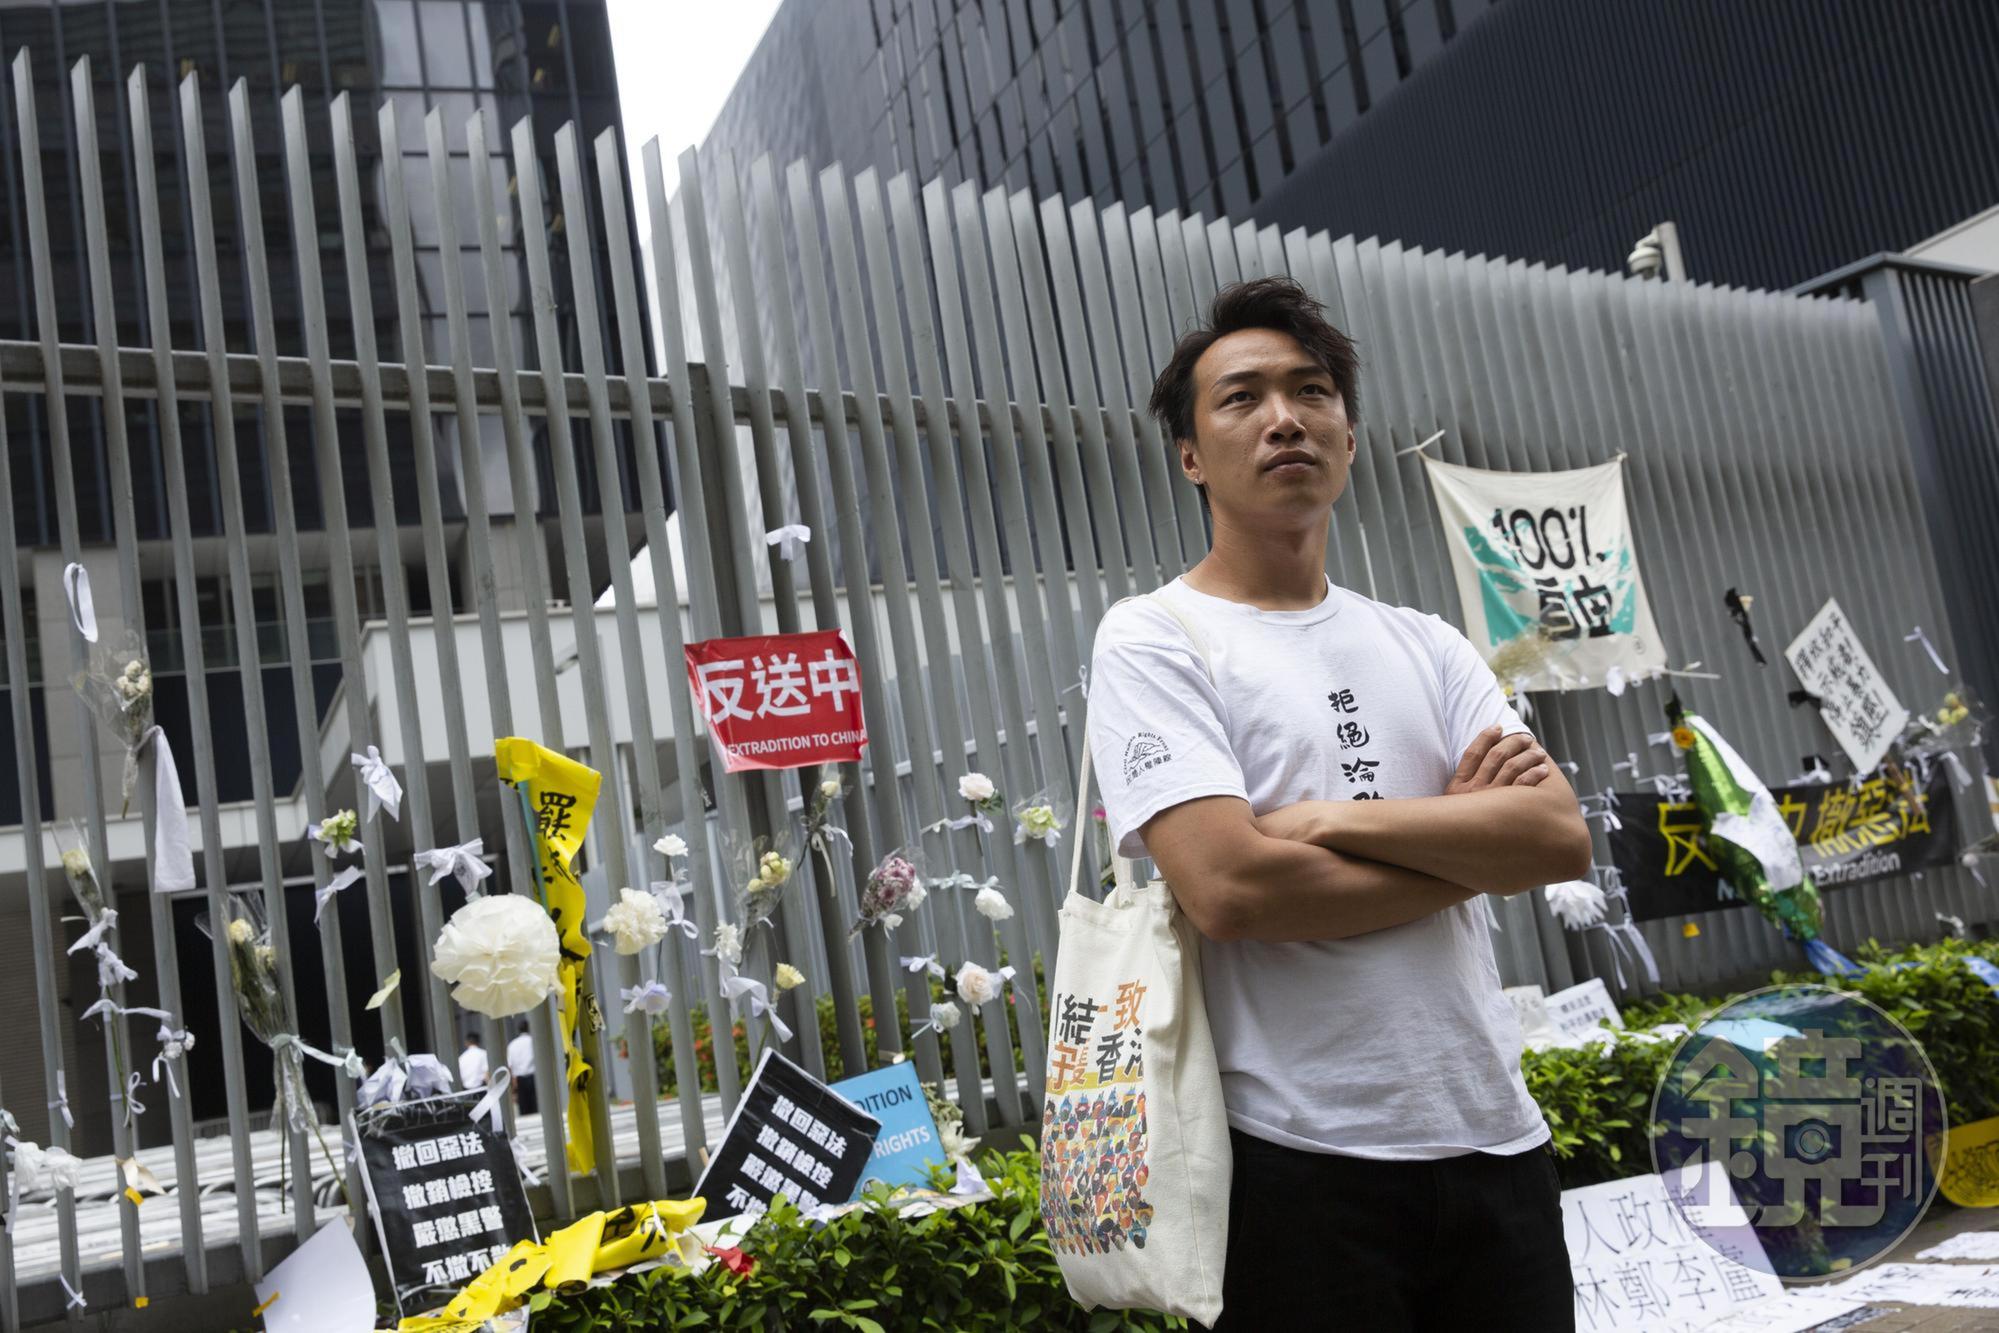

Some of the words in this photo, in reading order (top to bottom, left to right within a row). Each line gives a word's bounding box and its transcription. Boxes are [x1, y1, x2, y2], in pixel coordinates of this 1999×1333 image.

[696, 649, 859, 725] 反送中
[727, 735, 811, 756] EXTRADITION
[813, 733, 830, 747] TO
[831, 729, 867, 745] CHINA
[853, 1084, 913, 1114] DITION
[770, 1094, 849, 1160] 撤回惡法
[873, 1126, 931, 1159] RIGHTS
[391, 1131, 487, 1172] 撤回惡法
[756, 1123, 835, 1190] 撤銷檢控
[402, 1169, 496, 1210] 撤銷檢控
[412, 1205, 504, 1250] 嚴懲黑警
